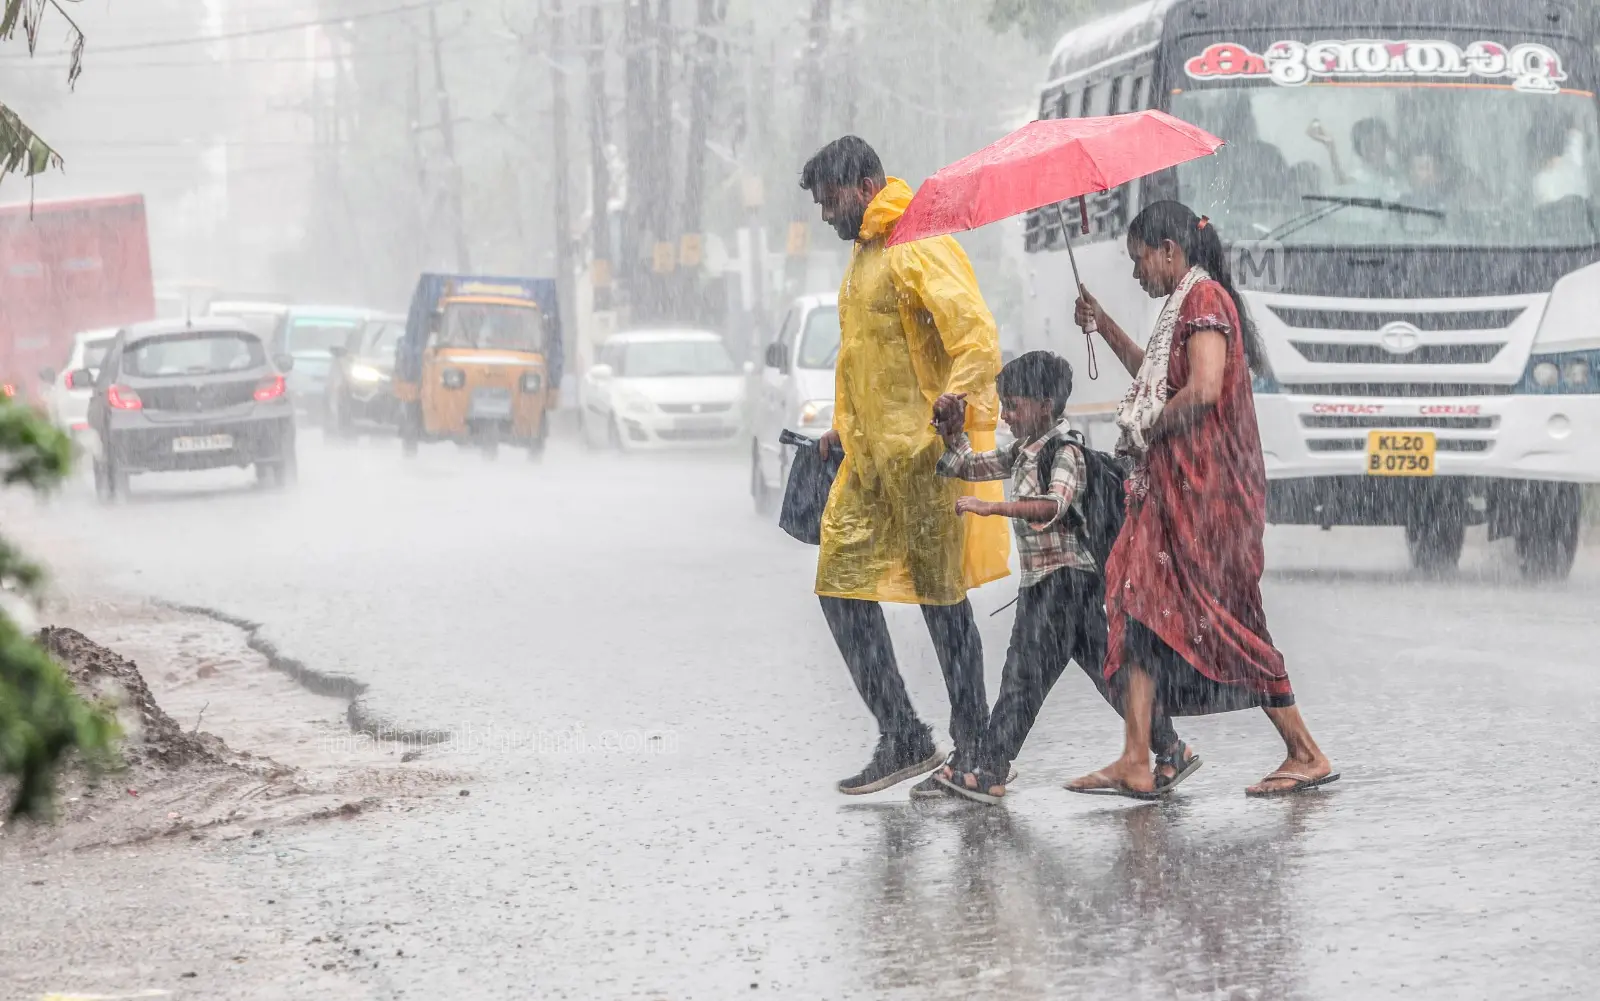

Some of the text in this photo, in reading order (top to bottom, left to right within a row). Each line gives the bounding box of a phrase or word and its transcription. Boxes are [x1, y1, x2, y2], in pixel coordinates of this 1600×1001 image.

[1312, 403, 1482, 415] CONTRACT CARRIAGE
[1378, 436, 1424, 451] KL20
[1370, 455, 1429, 470] B 0730
